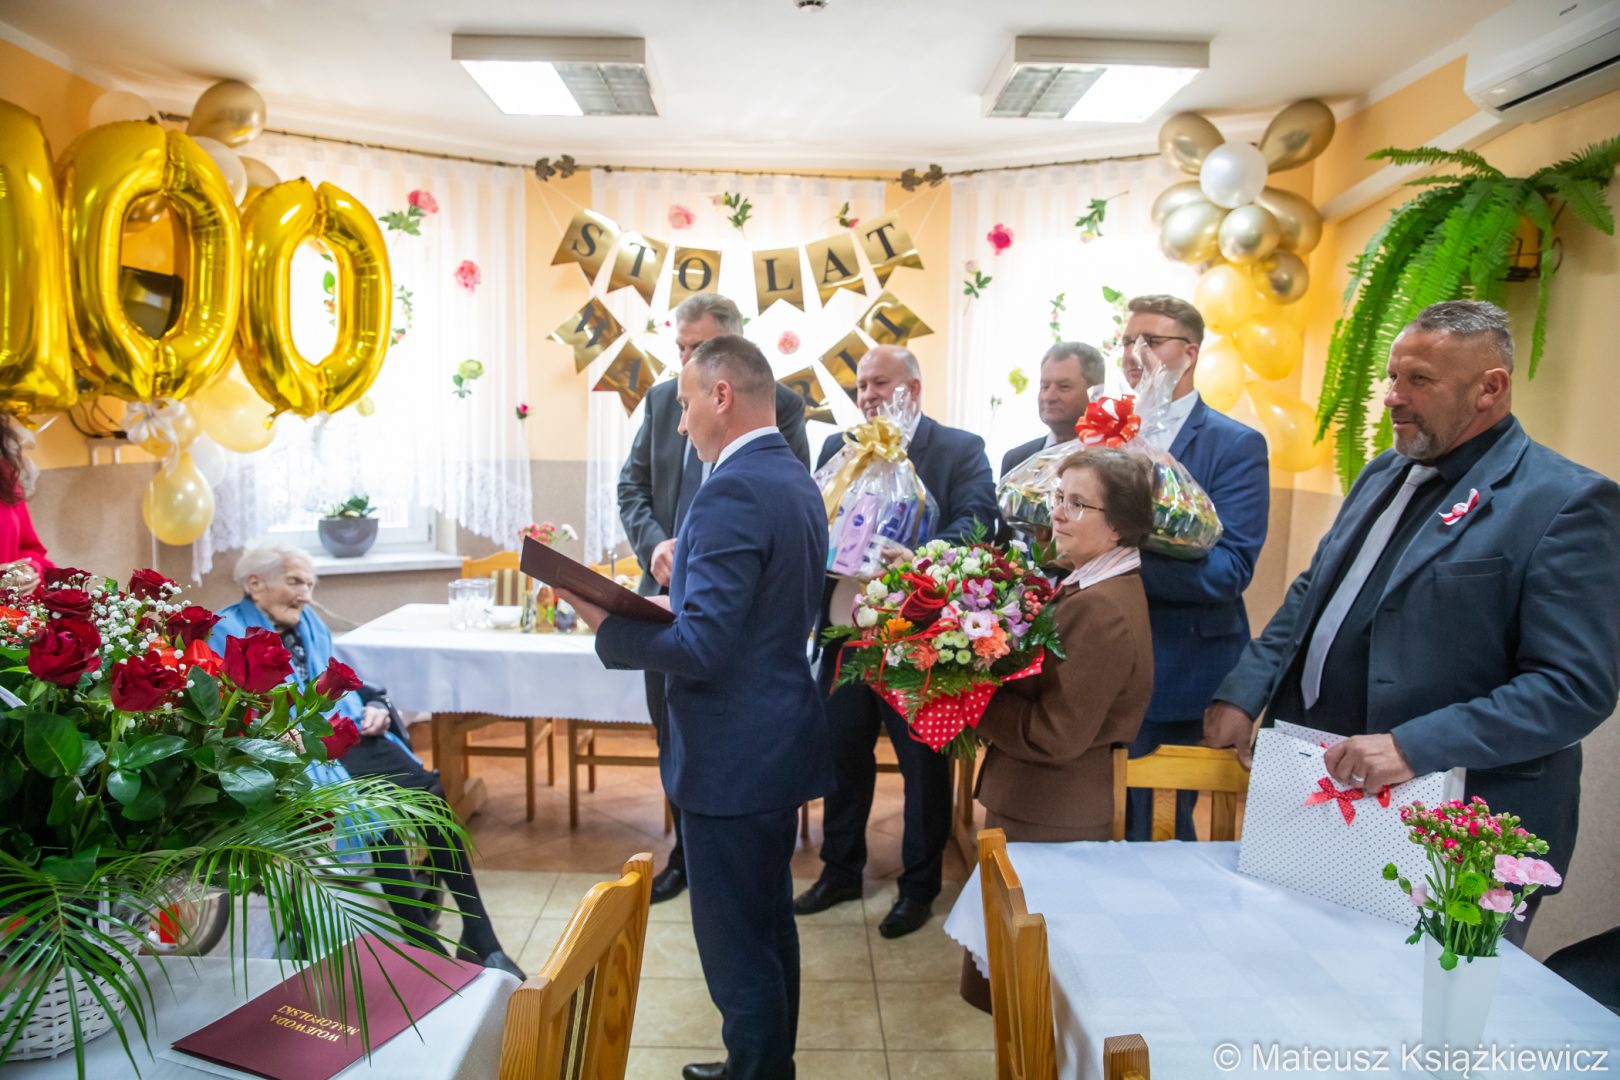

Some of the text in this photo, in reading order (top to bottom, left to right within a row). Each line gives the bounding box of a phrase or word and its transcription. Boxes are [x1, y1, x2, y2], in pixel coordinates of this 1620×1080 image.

[571, 222, 896, 292] STO LAT
[270, 1014, 341, 1042] WOJEWODA
